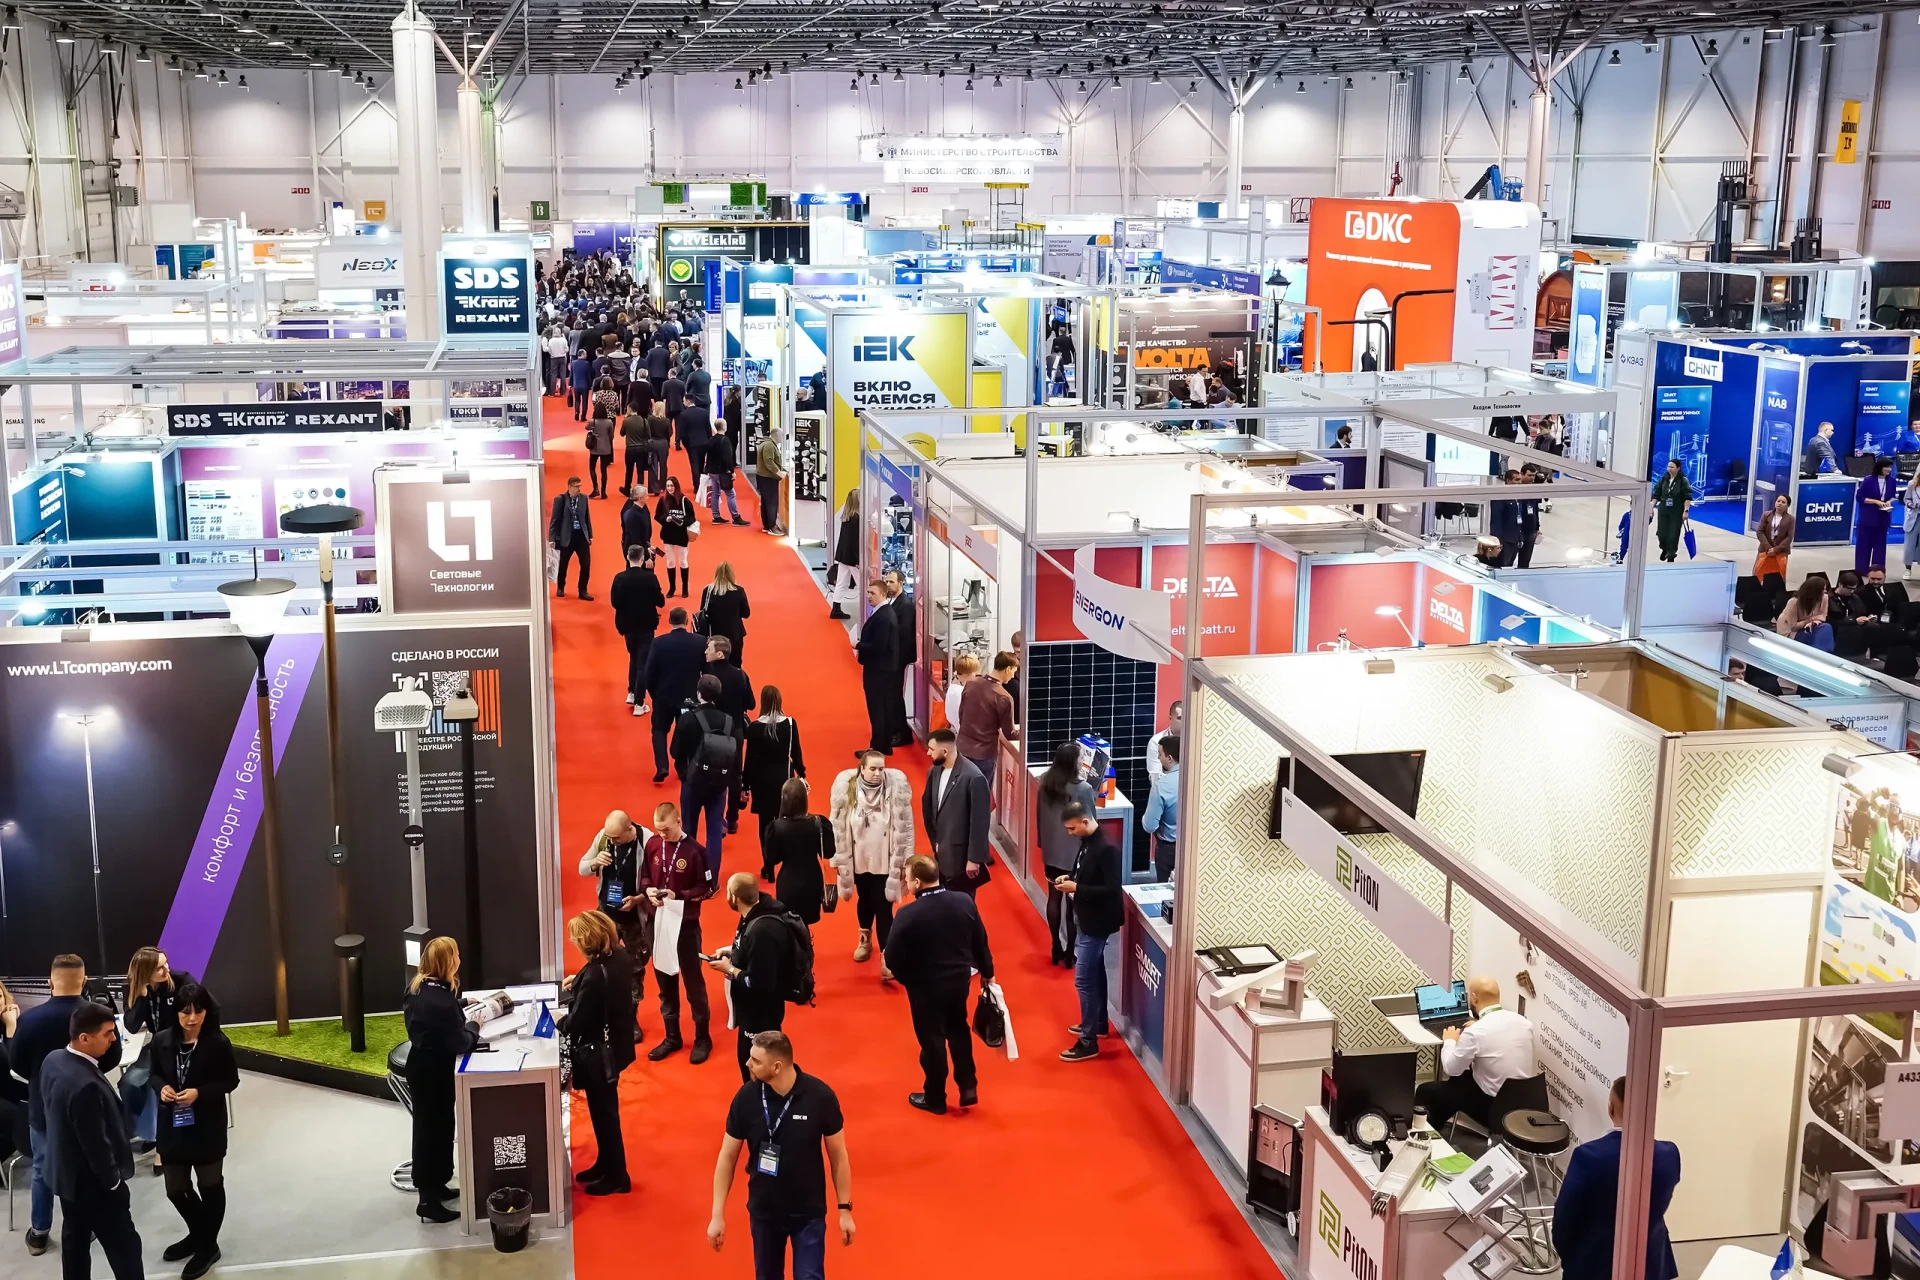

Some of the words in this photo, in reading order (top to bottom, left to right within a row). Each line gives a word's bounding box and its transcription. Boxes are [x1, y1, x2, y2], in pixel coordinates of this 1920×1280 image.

[453, 267, 520, 289] SDS
[468, 295, 520, 308] Kranz
[455, 314, 520, 322] REXANT
[1147, 339, 1187, 347] КАЧЕСТВО
[854, 381, 911, 391] ВКЛЮ
[854, 393, 935, 404] ЧАЕМСЯ
[1768, 396, 1787, 409] NA8
[173, 414, 212, 428] SDS
[234, 412, 288, 426] Kranz
[295, 412, 378, 427] REXANT
[429, 569, 481, 579] Световые
[430, 582, 494, 593] Технологии
[1163, 576, 1238, 594] DETA
[1075, 590, 1124, 630] ENERGON
[1430, 597, 1464, 629] DELTA
[1171, 624, 1236, 636] eltatt.ru
[391, 650, 445, 662] СДЕЛАНО
[446, 649, 454, 658] В
[455, 648, 499, 659] РОССИИ
[7, 659, 173, 677] www.LTcompany.com
[417, 735, 446, 744] ЕЕСТРЕ
[417, 743, 453, 752] ОДУКЦИИ
[1135, 943, 1162, 985] SMART
[1137, 960, 1159, 997] WATT
[1543, 993, 1578, 1031] ТОКОПРОВОДЫ
[1592, 992, 1618, 1019] СИСТЕМЫ
[1539, 1034, 1562, 1060] ПИТАНИЯ
[1540, 1021, 1564, 1048] СИСТЕМЫ
[1564, 1042, 1611, 1089] БЕСПЕРЕБОЙНОГО
[1537, 1059, 1584, 1108] СВЕТОТЕХНИЧЕСКОЕ
